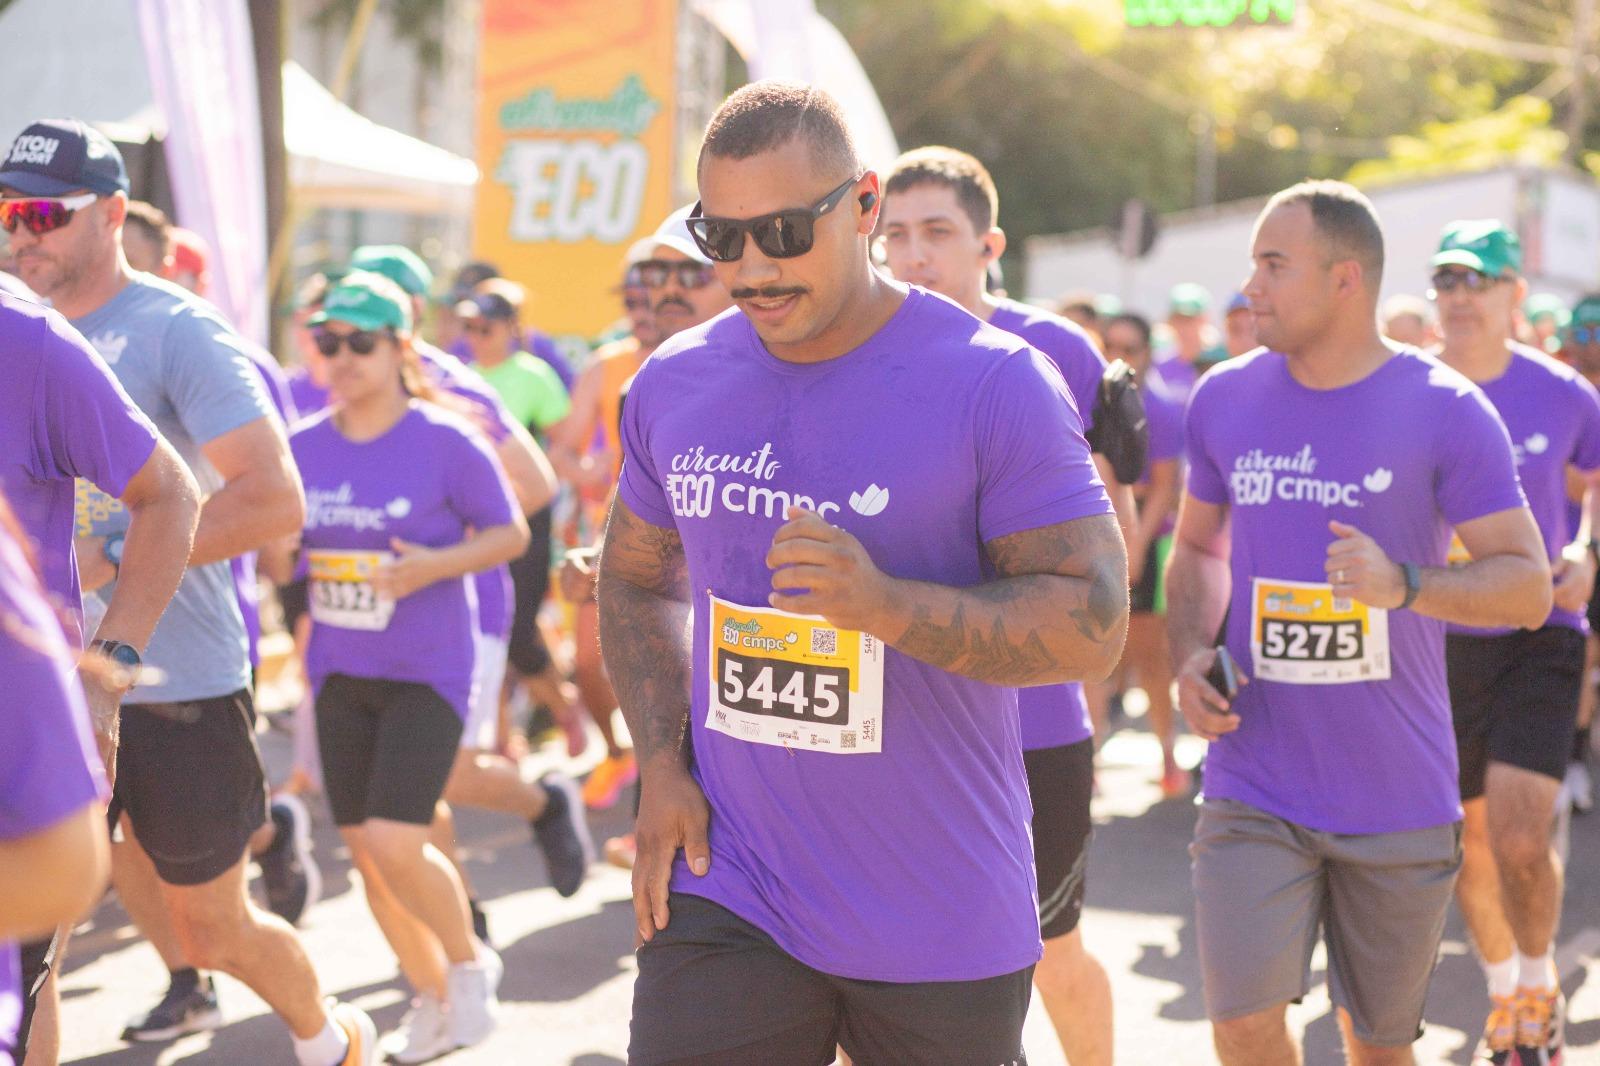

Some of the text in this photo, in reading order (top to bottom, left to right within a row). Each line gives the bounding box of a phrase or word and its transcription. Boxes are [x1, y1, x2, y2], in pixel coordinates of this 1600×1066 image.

[500, 142, 648, 242] ECO
[671, 443, 782, 480] circuito
[667, 473, 715, 518] ECO
[1230, 470, 1361, 508] ECO cmpc
[722, 626, 785, 652] ECO cmpc
[1265, 621, 1359, 659] 5275
[723, 658, 840, 718] 5445
[863, 719, 871, 740] 5445
